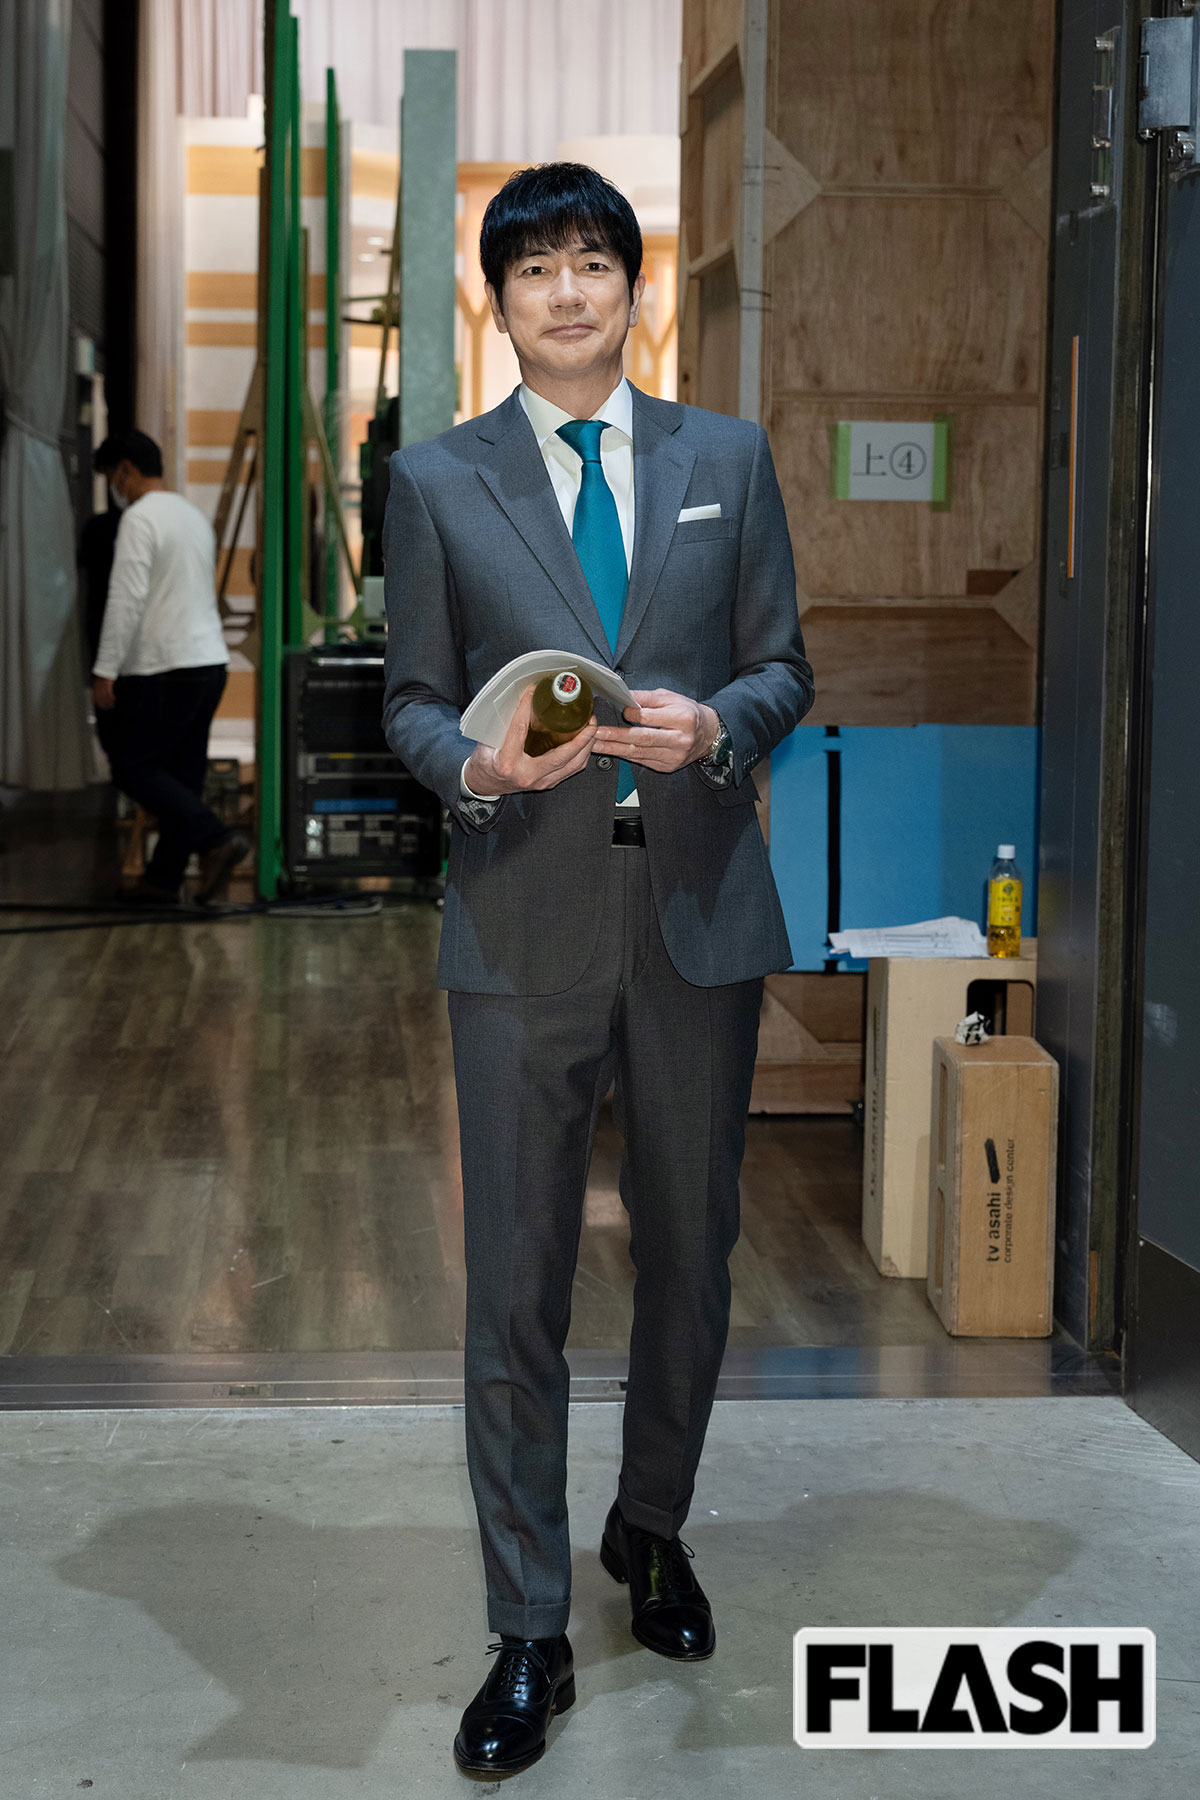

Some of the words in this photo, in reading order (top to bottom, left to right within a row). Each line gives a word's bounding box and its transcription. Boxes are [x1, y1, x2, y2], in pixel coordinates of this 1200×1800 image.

[1005, 1138, 1015, 1172] center
[1004, 1175, 1015, 1210] design
[987, 1192, 1001, 1240] asahi
[986, 1245, 999, 1262] tv
[1004, 1212, 1014, 1263] corporate
